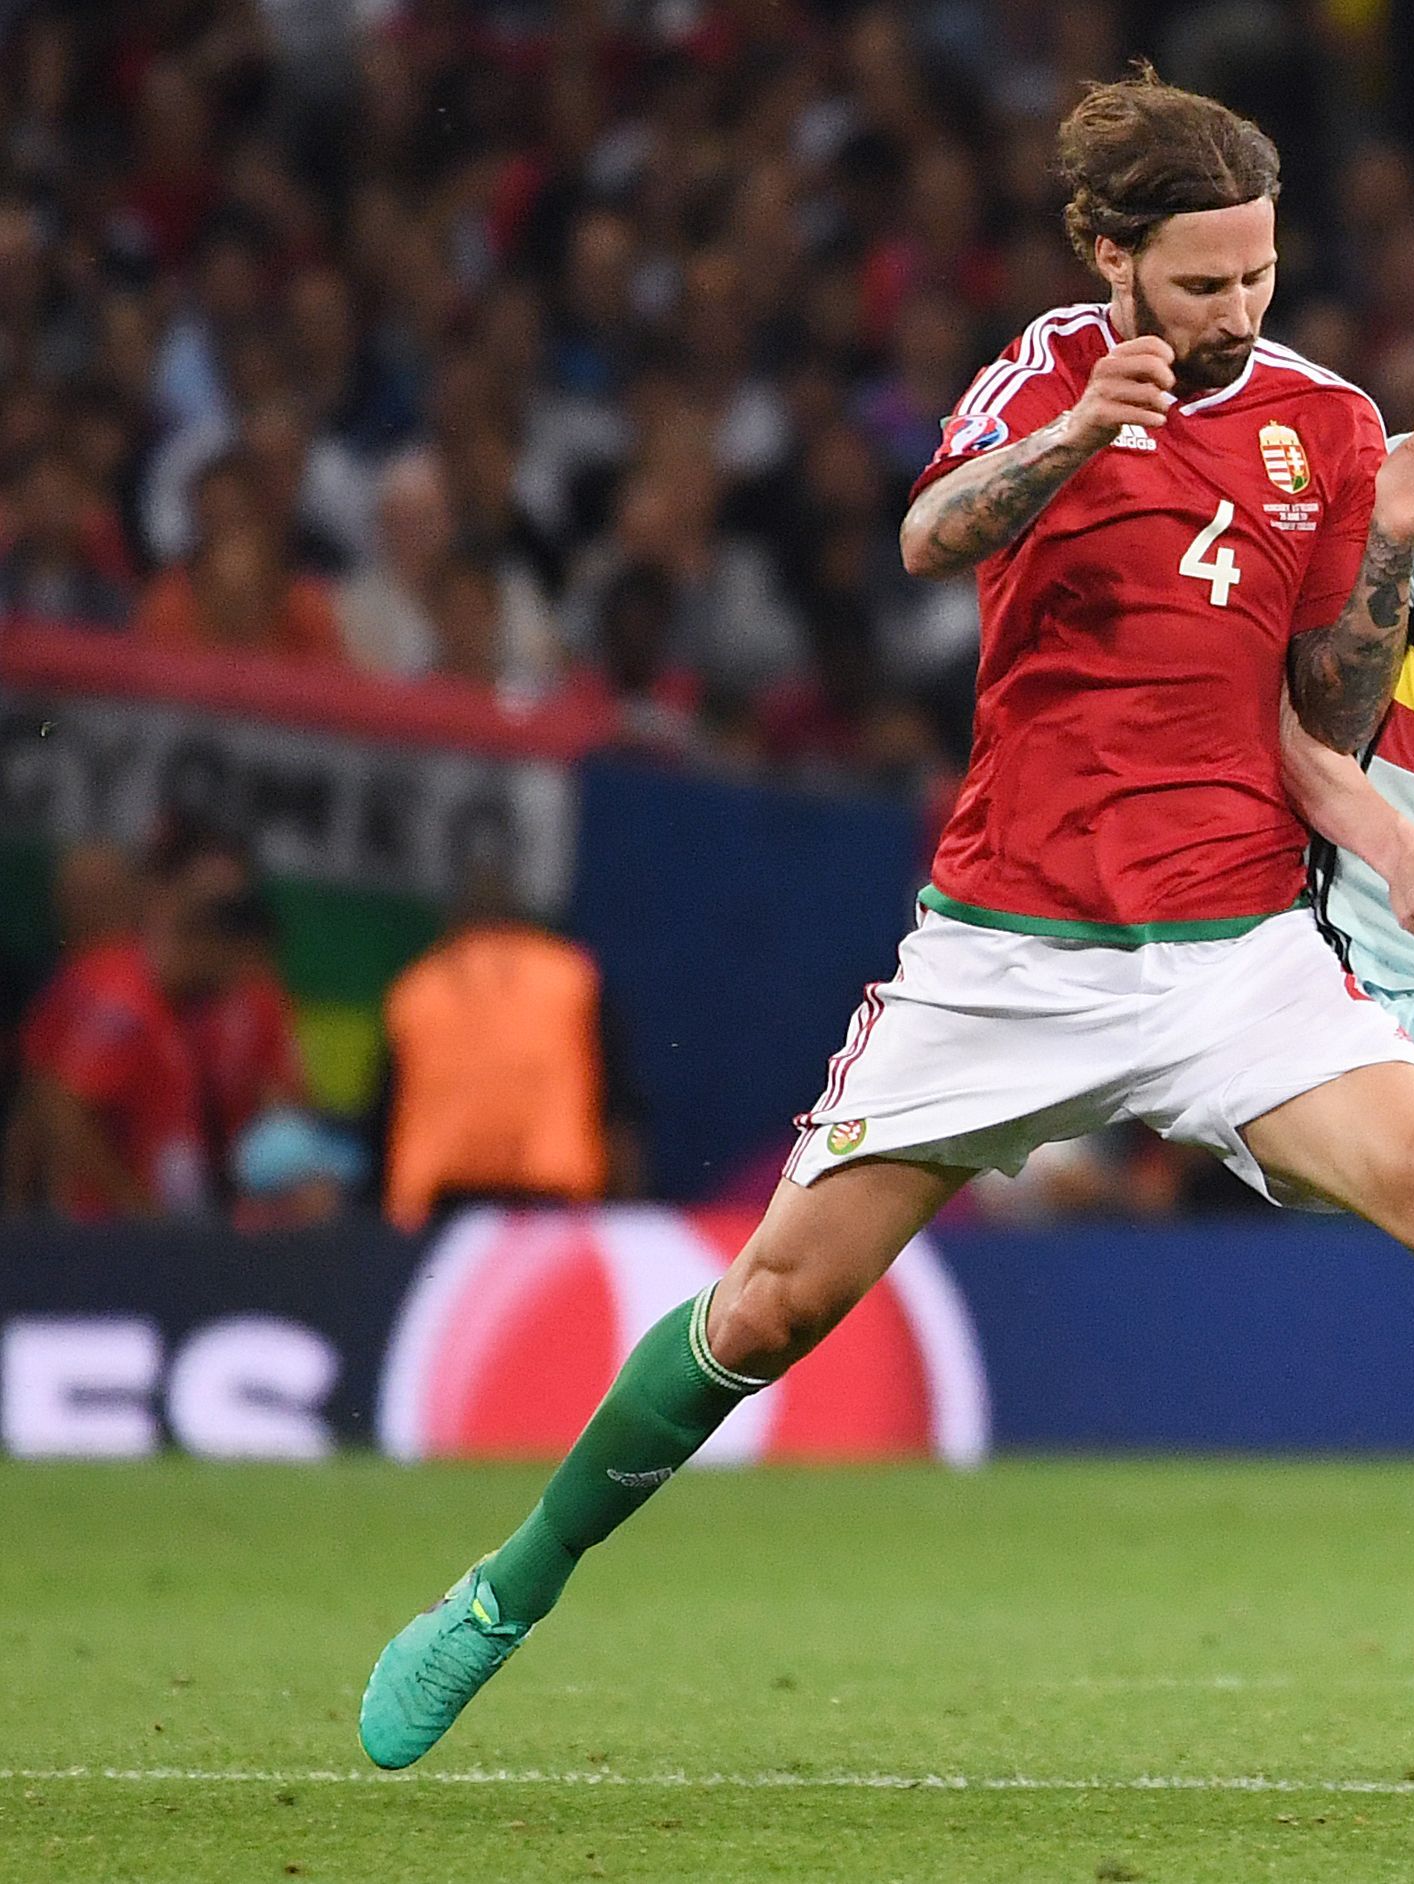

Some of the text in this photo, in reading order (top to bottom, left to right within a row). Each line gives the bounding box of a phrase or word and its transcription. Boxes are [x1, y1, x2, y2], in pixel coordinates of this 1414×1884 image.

[1109, 434, 1157, 451] didas
[1179, 499, 1241, 606] 4
[2, 1315, 338, 1459] ES
